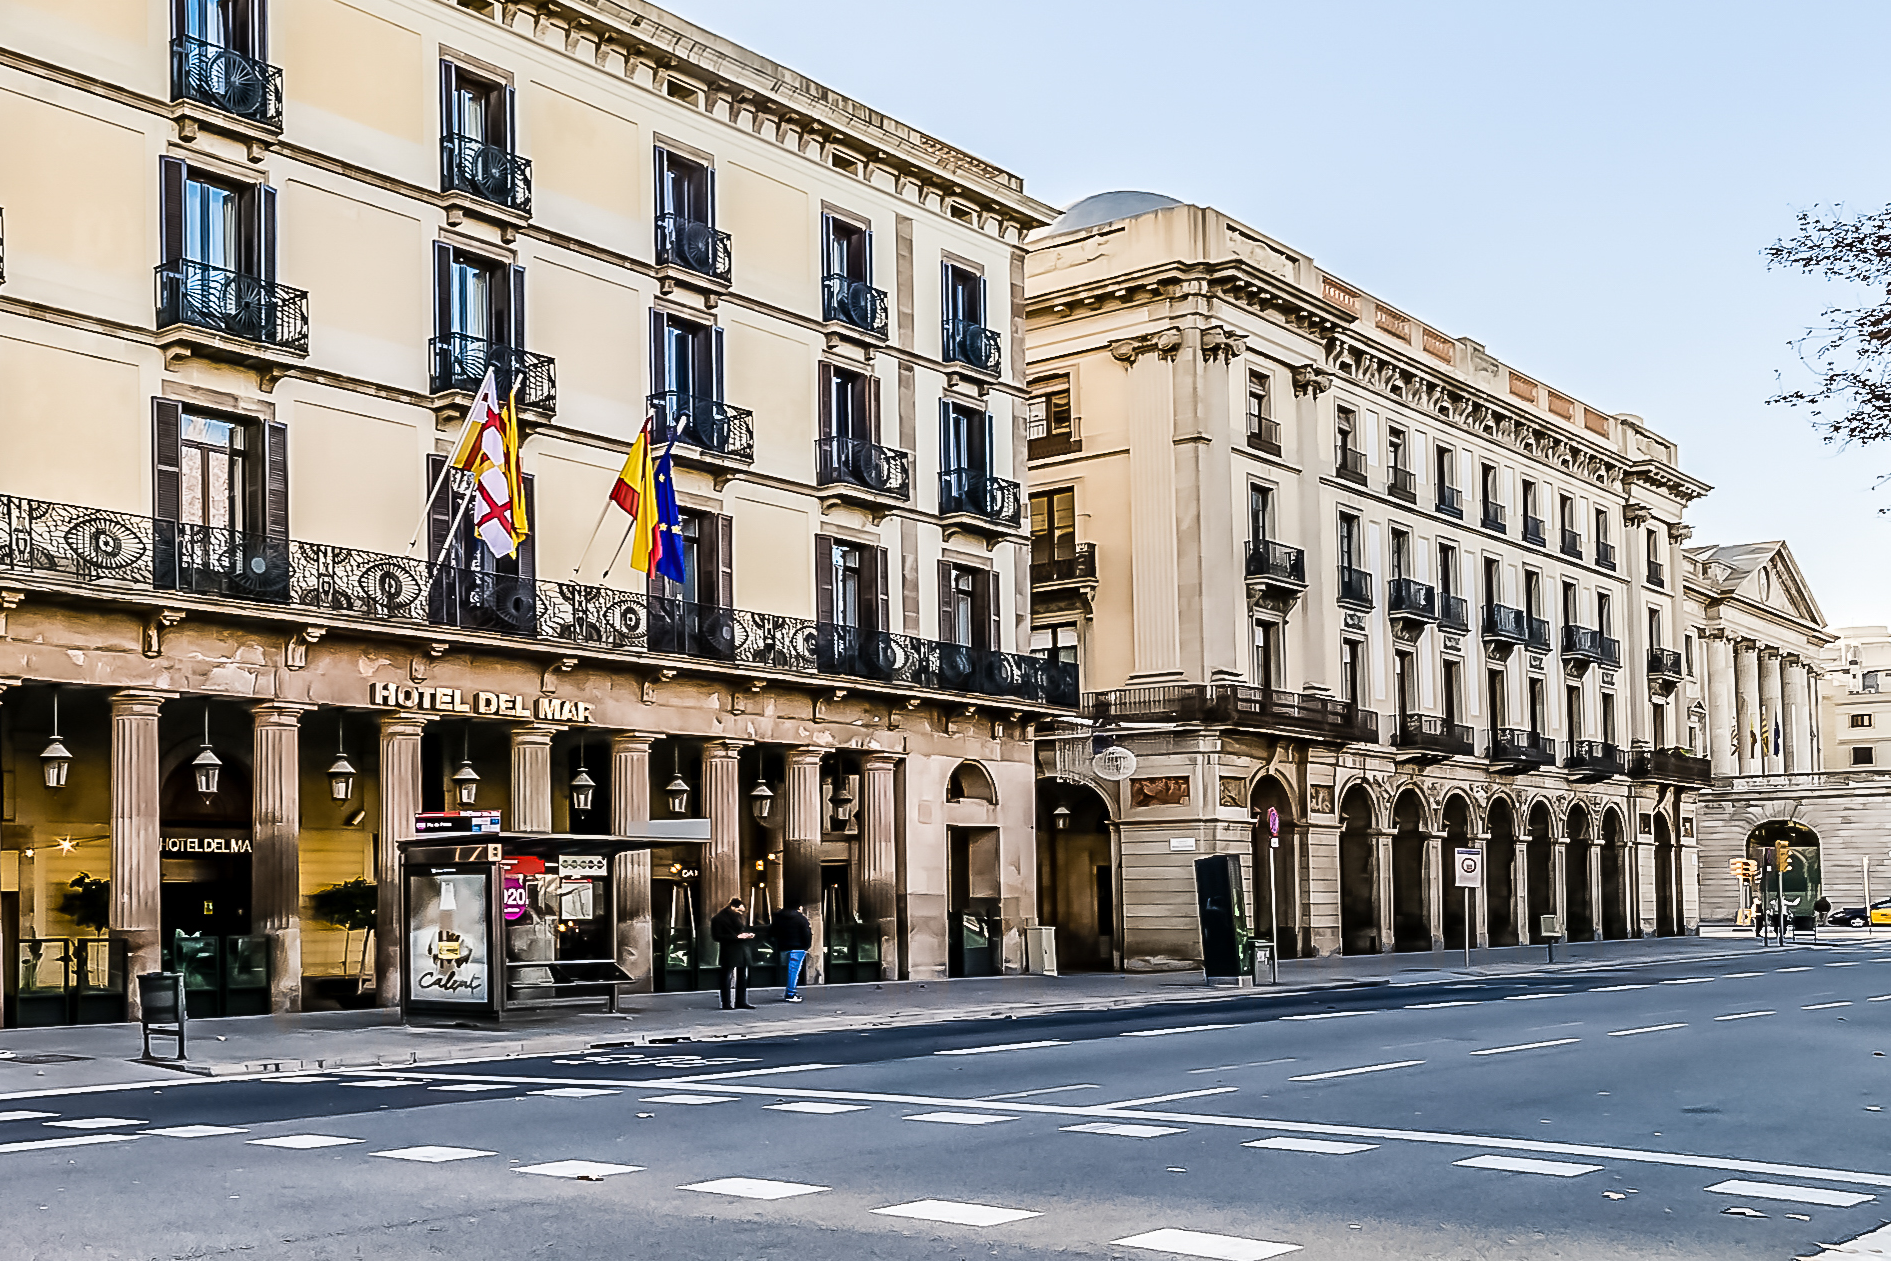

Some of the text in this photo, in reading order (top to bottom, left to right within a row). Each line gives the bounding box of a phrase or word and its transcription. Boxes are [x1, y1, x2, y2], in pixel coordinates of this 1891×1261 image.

[369, 682, 595, 723] HOTEL DEL MAR
[159, 837, 203, 852] HOTEL
[230, 838, 253, 853] MA
